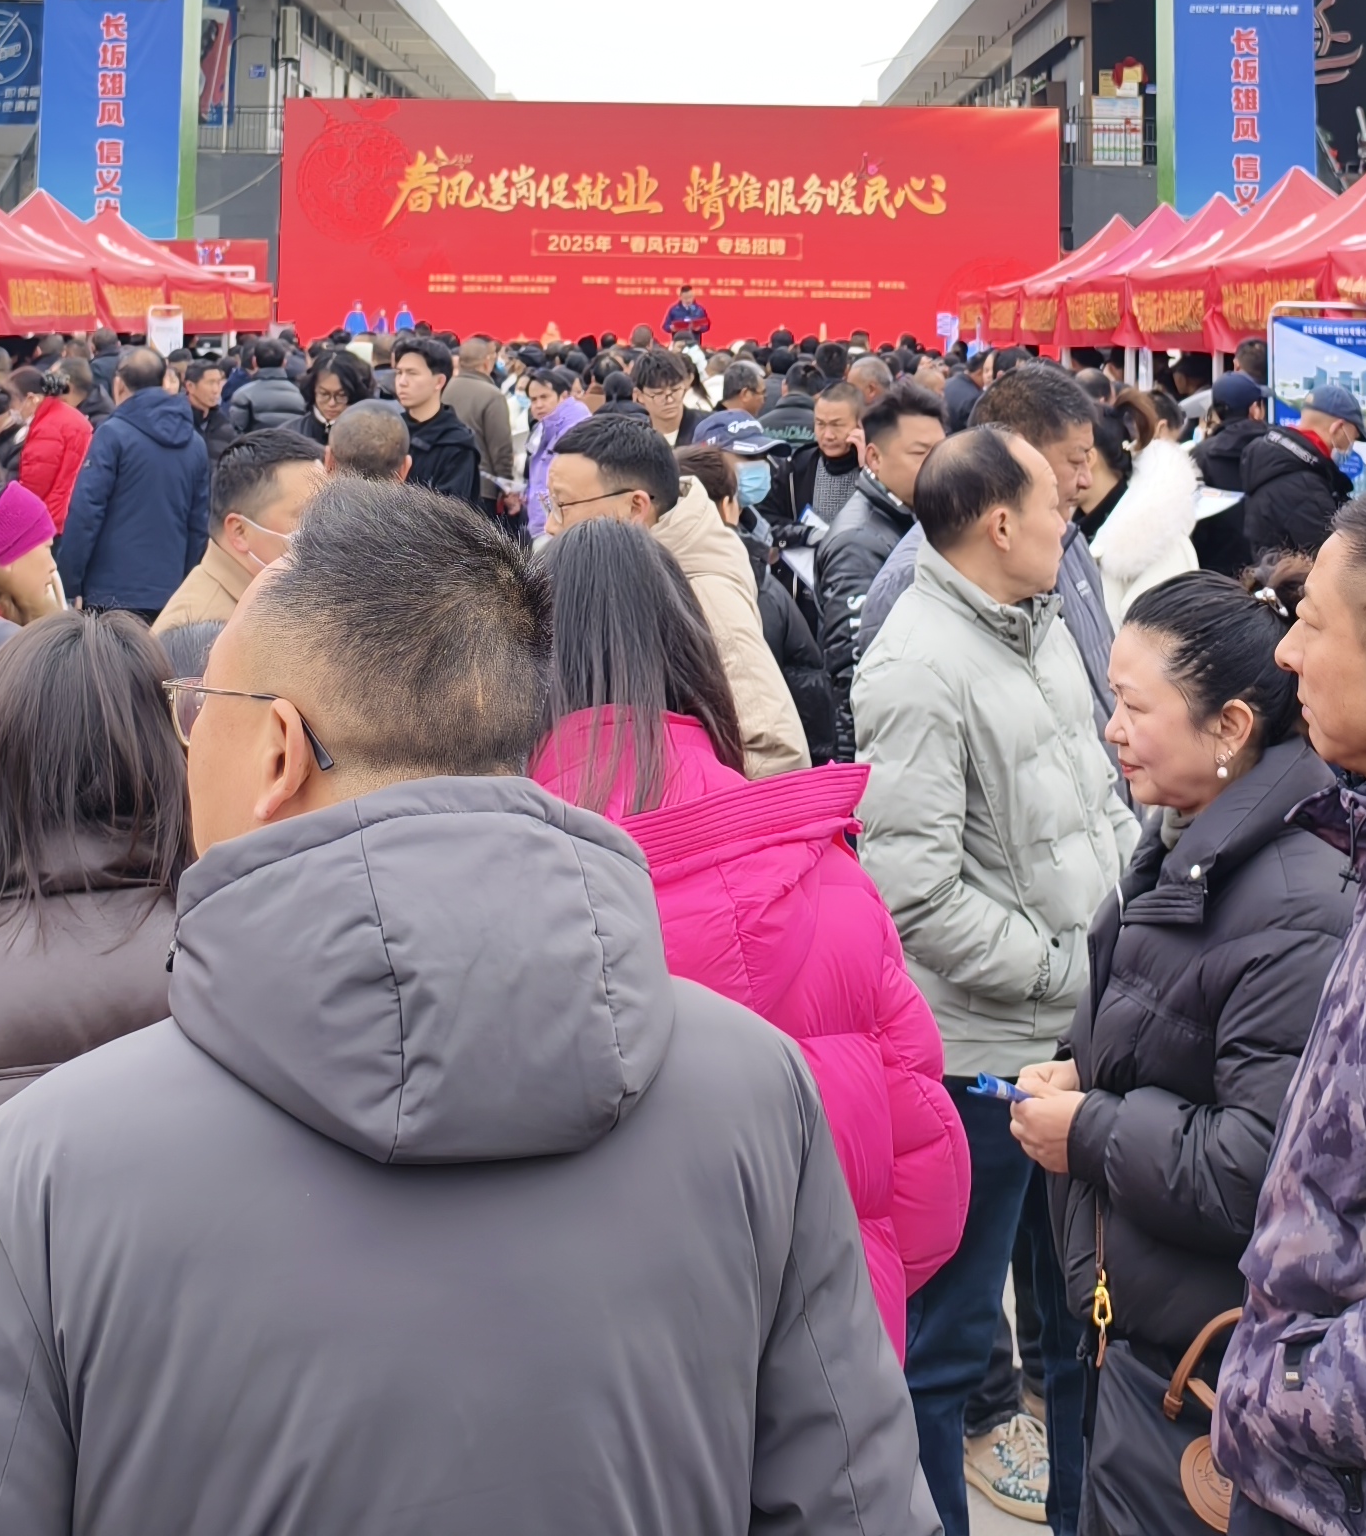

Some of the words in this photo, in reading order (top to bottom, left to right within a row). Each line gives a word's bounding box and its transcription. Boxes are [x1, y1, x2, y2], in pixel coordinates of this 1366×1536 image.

[96, 13, 127, 127] 长坂雄风
[1231, 27, 1260, 142] 长坂雄风
[383, 149, 664, 230] 春风送岗促就业
[682, 161, 947, 231] 精准服务暖民心
